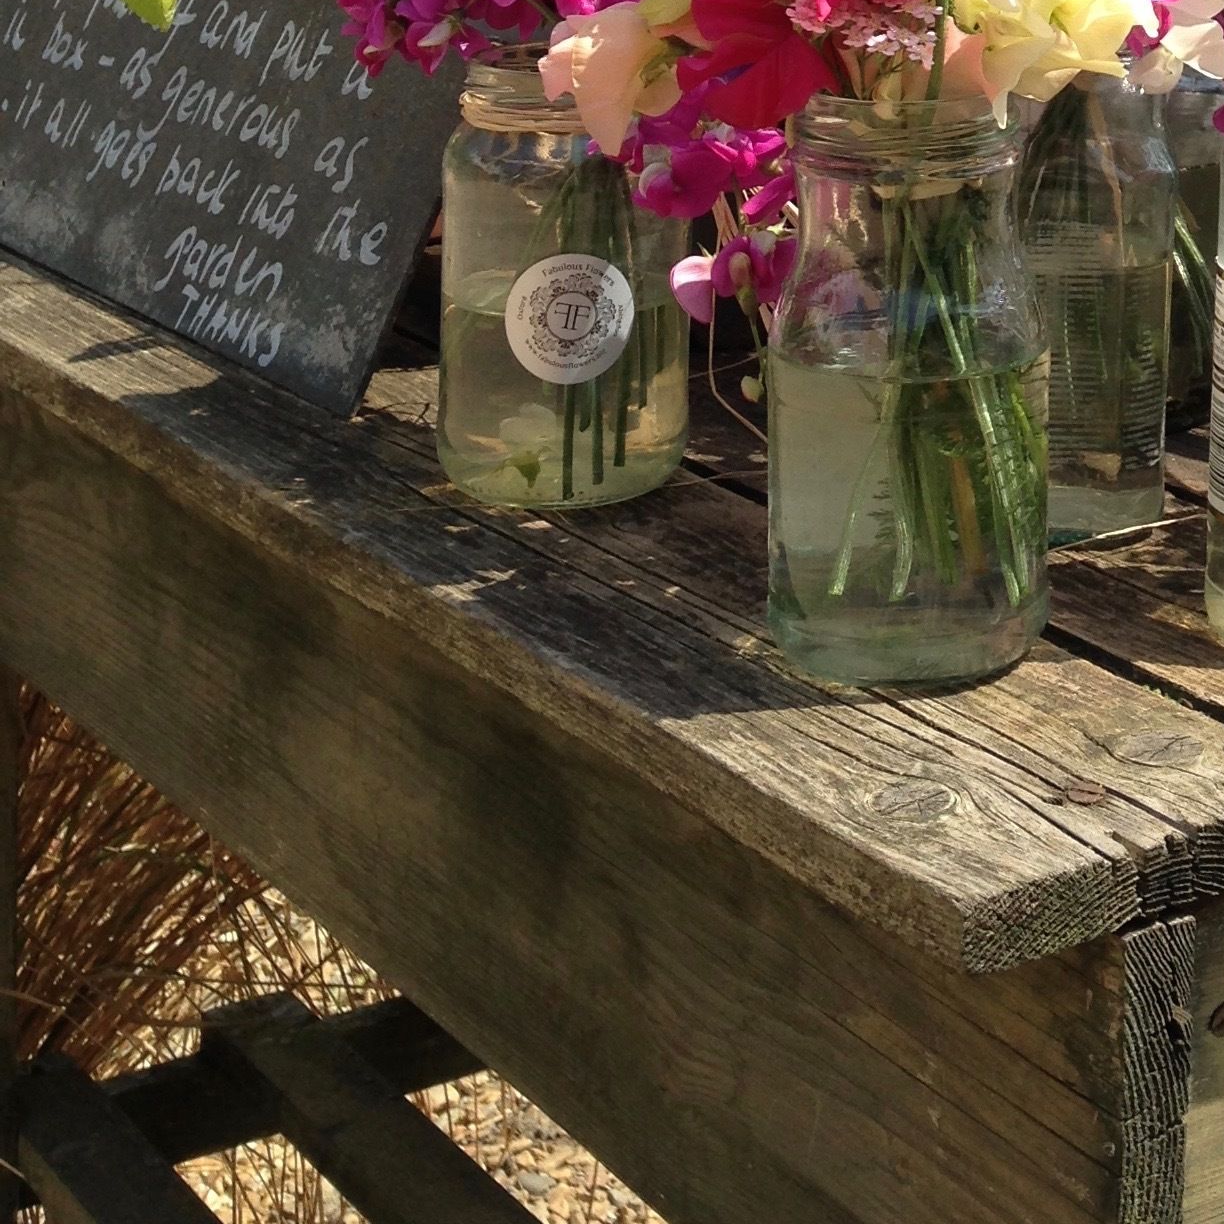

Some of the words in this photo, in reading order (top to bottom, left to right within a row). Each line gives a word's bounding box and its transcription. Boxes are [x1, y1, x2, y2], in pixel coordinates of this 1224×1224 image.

[42, 11, 88, 70] box
[120, 47, 156, 99] as
[200, 0, 267, 59] and
[258, 20, 333, 87] put
[136, 66, 300, 159] generous
[15, 79, 44, 129] it
[44, 98, 92, 148] all
[86, 120, 157, 188] goes
[155, 144, 240, 215] back
[314, 198, 387, 265] the
[313, 136, 369, 193] as
[152, 226, 283, 303] garden
[174, 283, 286, 367] THANKS
